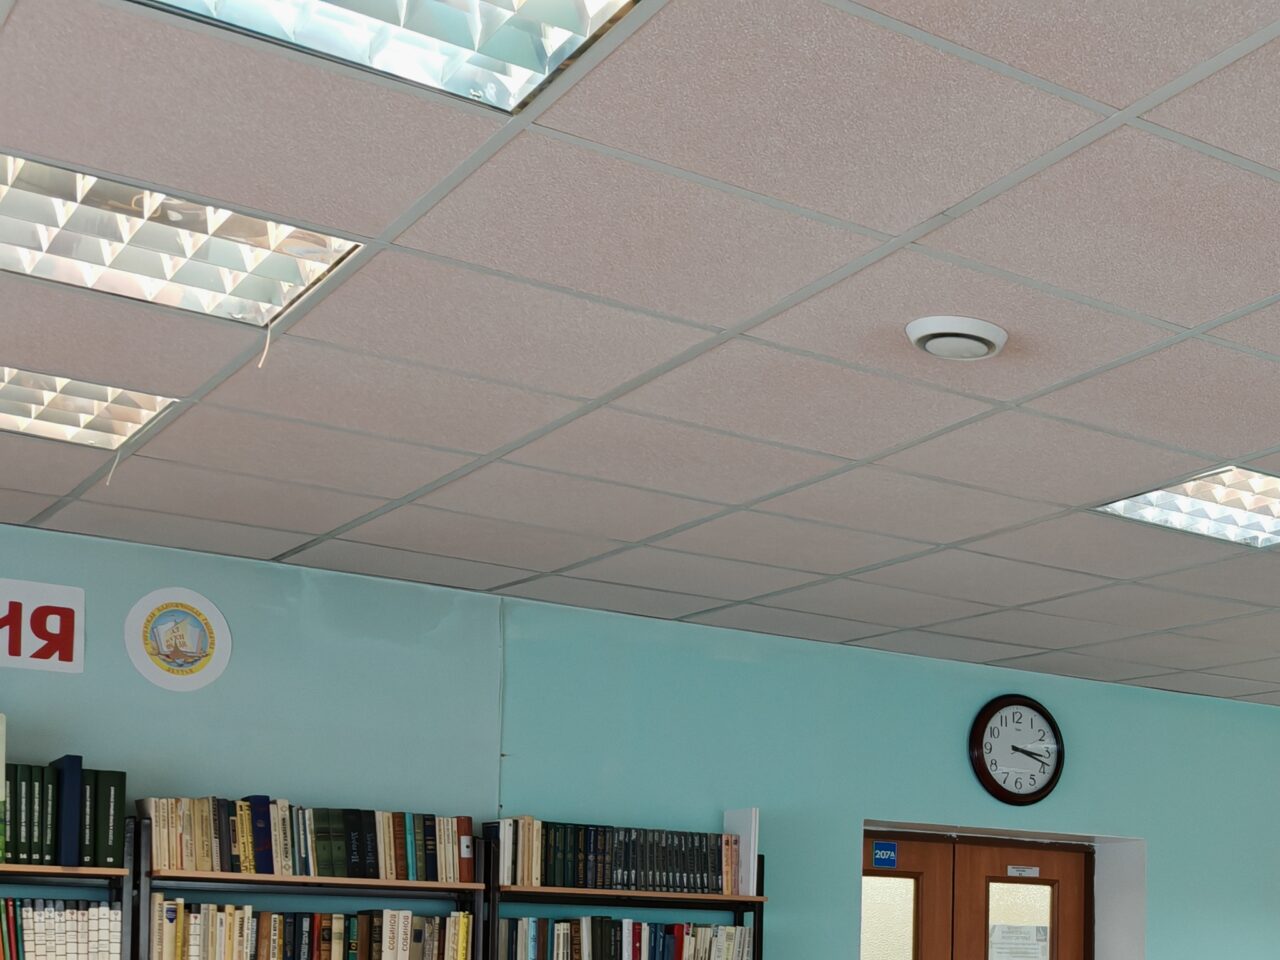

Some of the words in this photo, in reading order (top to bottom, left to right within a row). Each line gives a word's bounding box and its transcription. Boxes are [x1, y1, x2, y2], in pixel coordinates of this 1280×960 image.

[1000, 715, 1008, 727] 11
[1012, 711, 1022, 724] 12
[1030, 717, 1034, 729] 1
[990, 726, 1000, 739] 10
[1038, 729, 1046, 742] 2
[984, 742, 992, 754] 9
[1043, 746, 1051, 759] 3
[990, 758, 998, 772] 8
[1038, 761, 1046, 774] 4
[1001, 772, 1009, 784] 7
[1014, 777, 1022, 790] 6
[1029, 774, 1036, 786] 5
